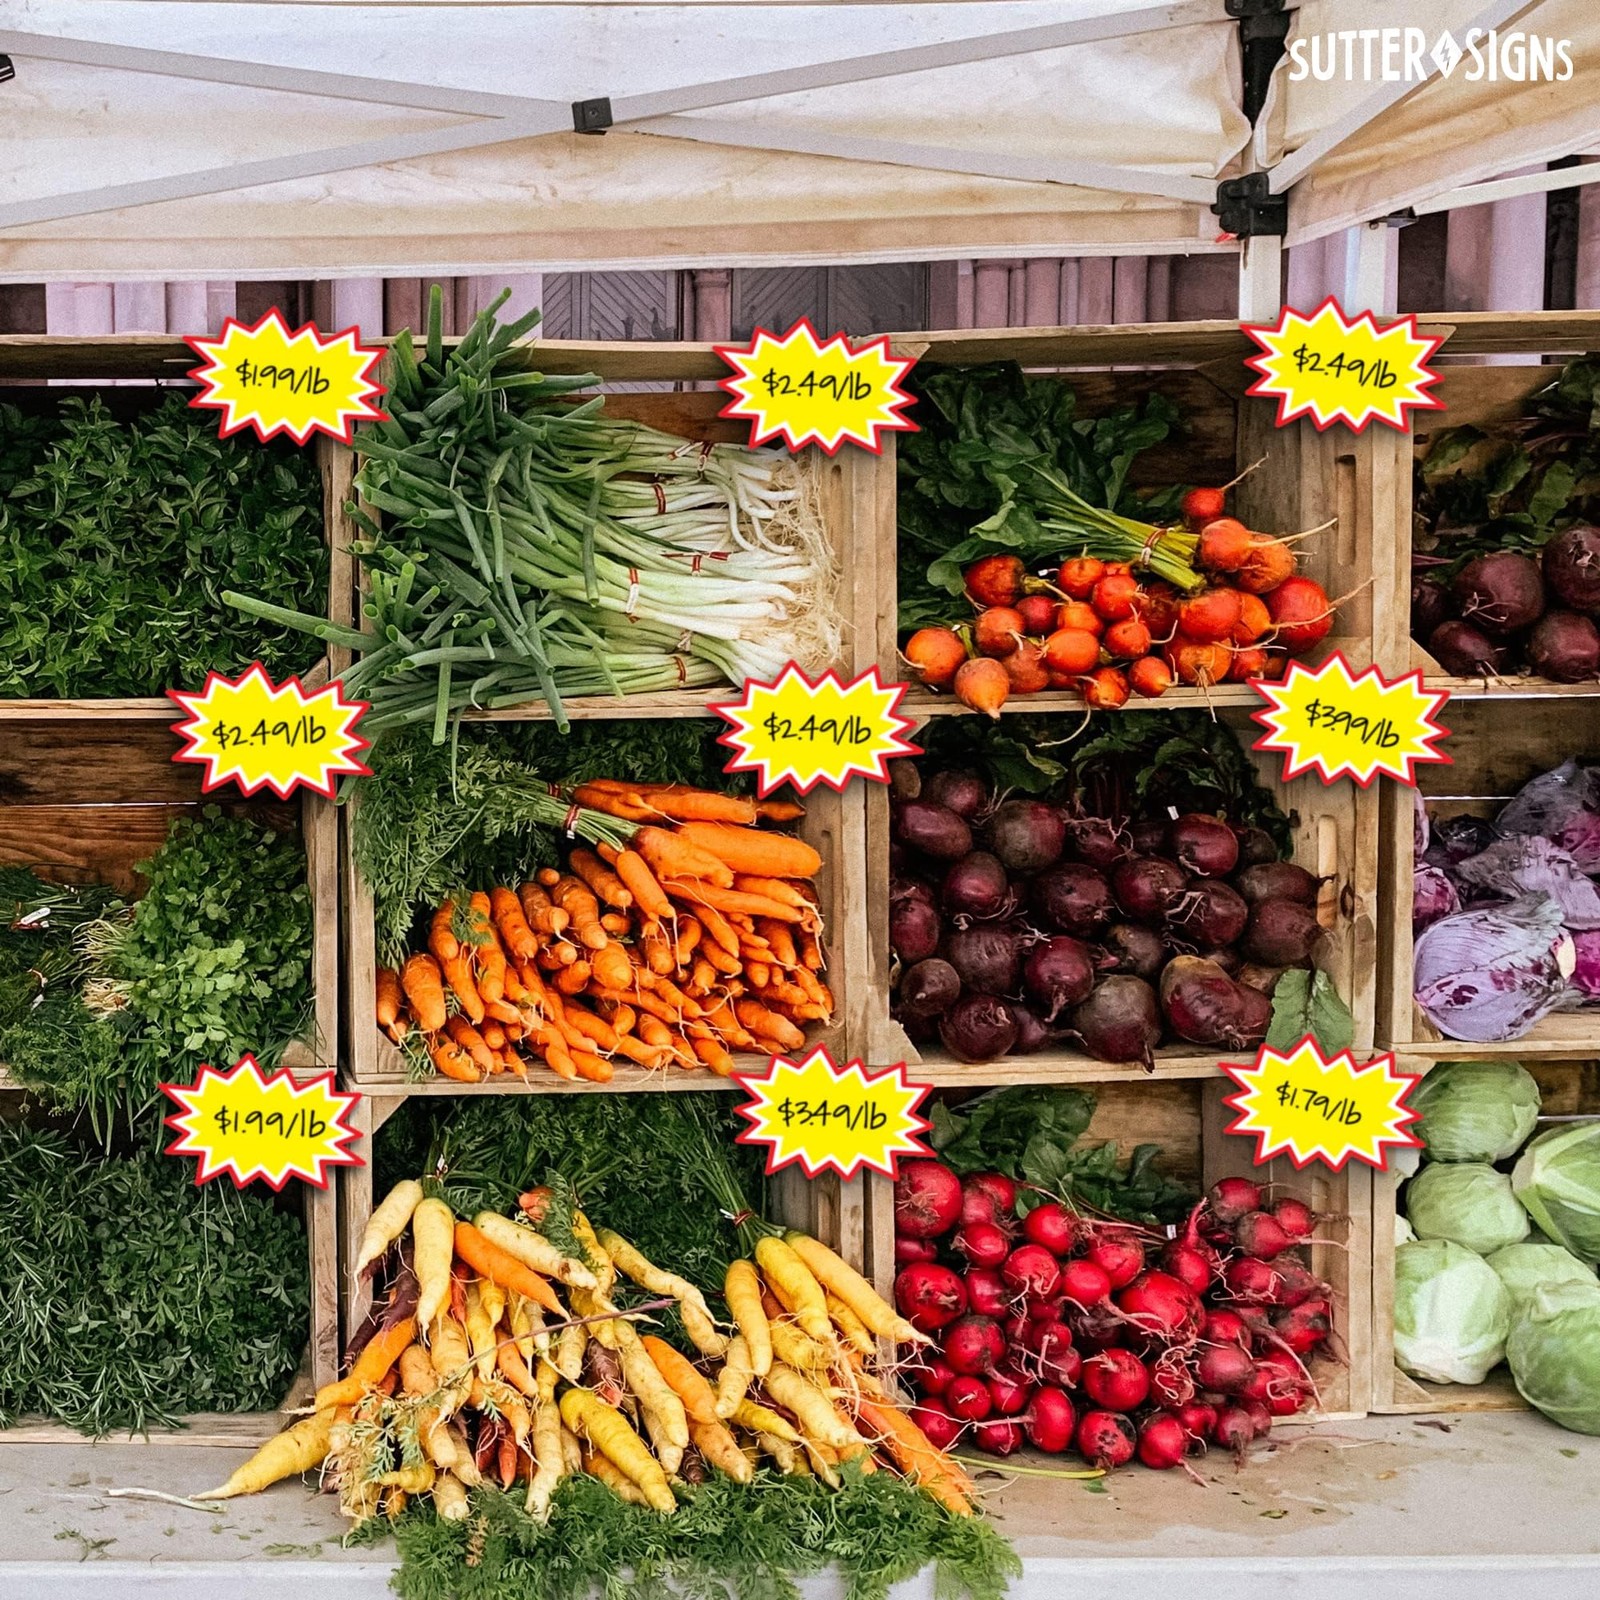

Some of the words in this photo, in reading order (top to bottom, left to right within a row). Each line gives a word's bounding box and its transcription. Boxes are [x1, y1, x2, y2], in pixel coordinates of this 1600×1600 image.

[236, 359, 329, 394] $1.99/lb
[1293, 344, 1396, 388] $2.49/lb
[762, 368, 871, 401] $2.49/lb
[213, 716, 326, 749] $2.49/lb
[764, 712, 871, 745] $2.49/lb
[1306, 699, 1399, 747] $3.99/lb
[778, 1098, 886, 1130] $3.49/lb
[1277, 1081, 1361, 1124] $1.79/lb
[214, 1106, 325, 1138] $1.99/lb
